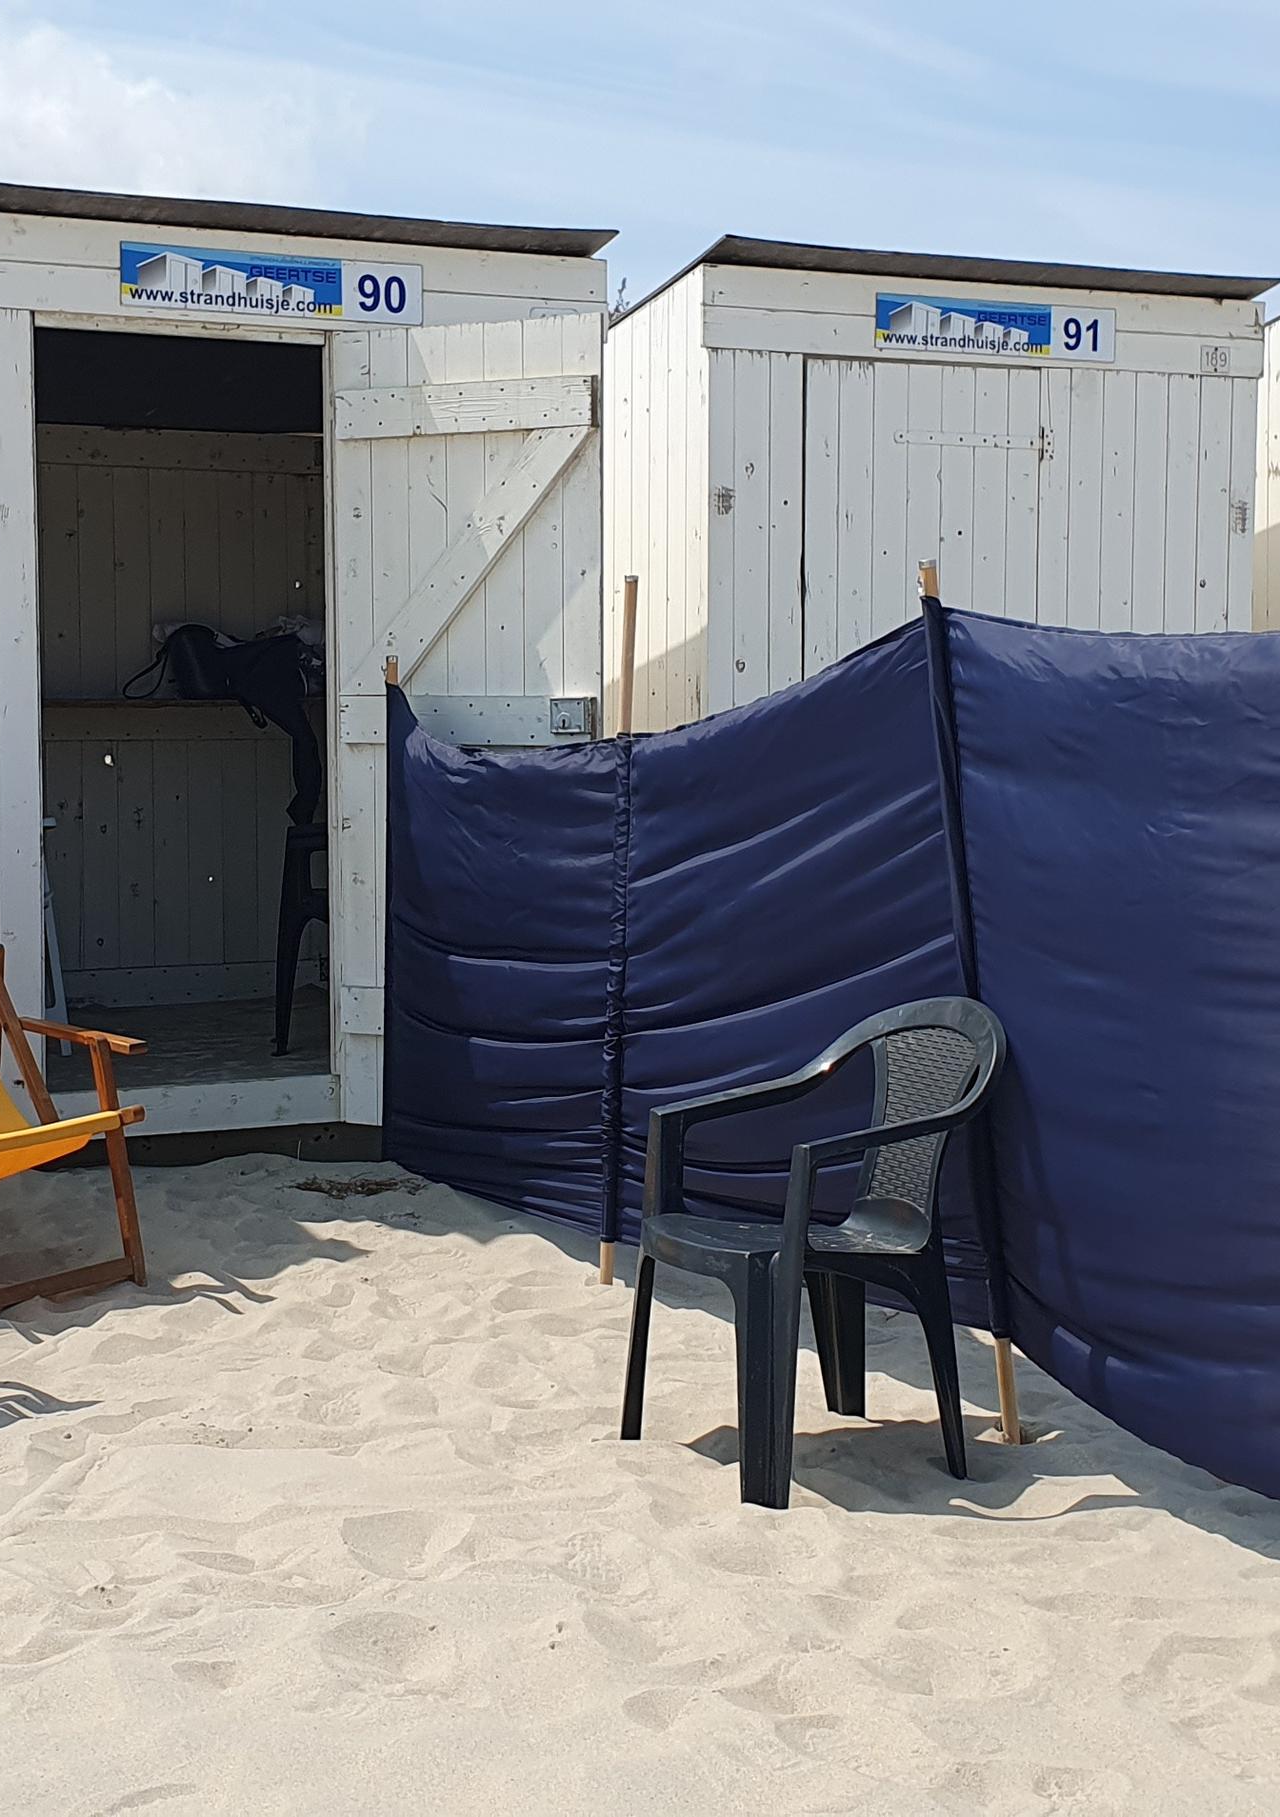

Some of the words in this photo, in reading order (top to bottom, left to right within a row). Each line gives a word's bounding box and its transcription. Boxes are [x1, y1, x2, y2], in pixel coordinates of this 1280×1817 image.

[249, 265, 337, 284] GEERTSE
[129, 286, 333, 315] www.strandhuisje.com
[357, 274, 407, 314] 90
[977, 312, 1047, 326] GEERTSE
[882, 331, 1043, 354] www.strandhuisje.com
[1063, 317, 1099, 353] 91
[1205, 351, 1228, 368] 189
